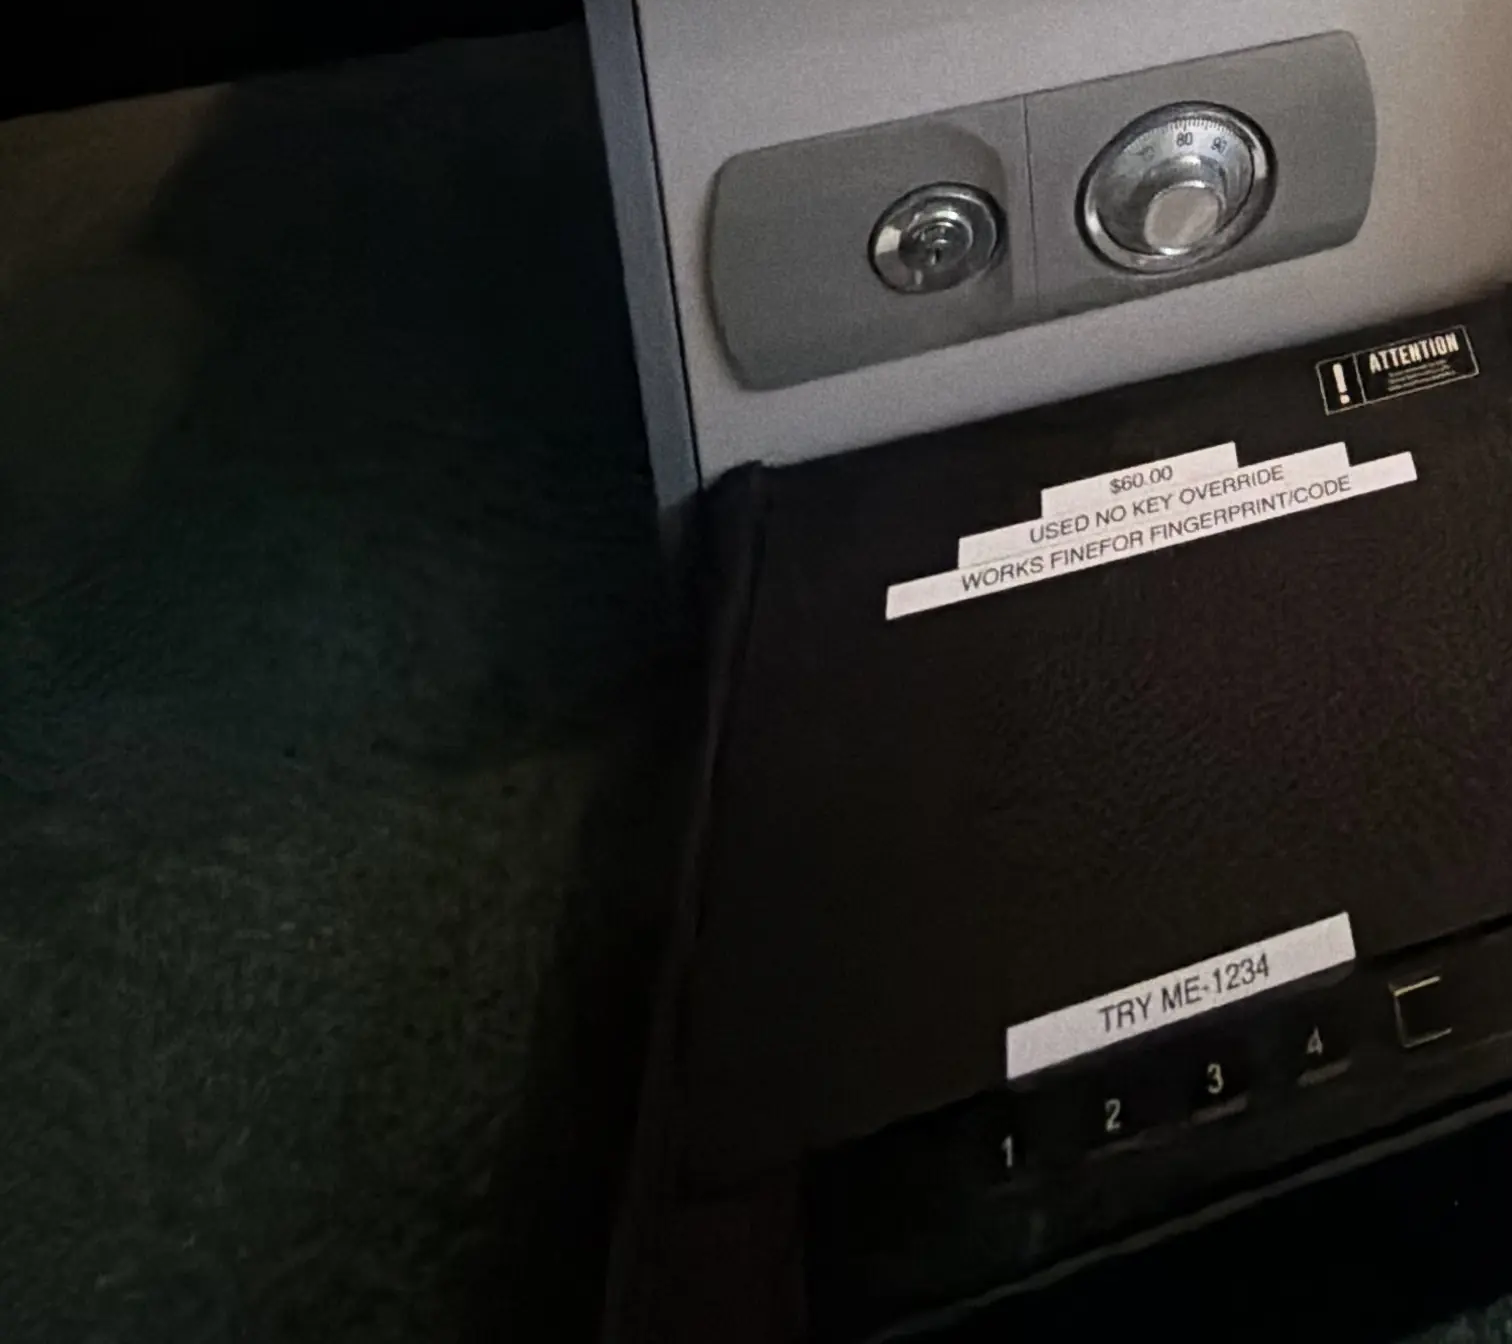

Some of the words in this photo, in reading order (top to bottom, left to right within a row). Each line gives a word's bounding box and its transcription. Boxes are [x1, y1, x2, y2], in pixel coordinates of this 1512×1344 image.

[1176, 132, 1193, 147] 80
[1369, 332, 1459, 374] ATTENTION
[961, 556, 1044, 592] WORKS
[1150, 475, 1352, 544] FINGERPRINT/CODE
[1029, 515, 1089, 544] USED
[1095, 504, 1126, 528] NO
[1132, 493, 1173, 518] KEY
[1180, 465, 1284, 505] OVERRIDE
[1098, 997, 1152, 1032] TRY
[1161, 953, 1270, 1012] ME-1234
[1002, 1136, 1013, 1167] 1
[1105, 1099, 1121, 1130] 2
[1207, 1064, 1223, 1094] 3
[1306, 1027, 1323, 1055] 4
